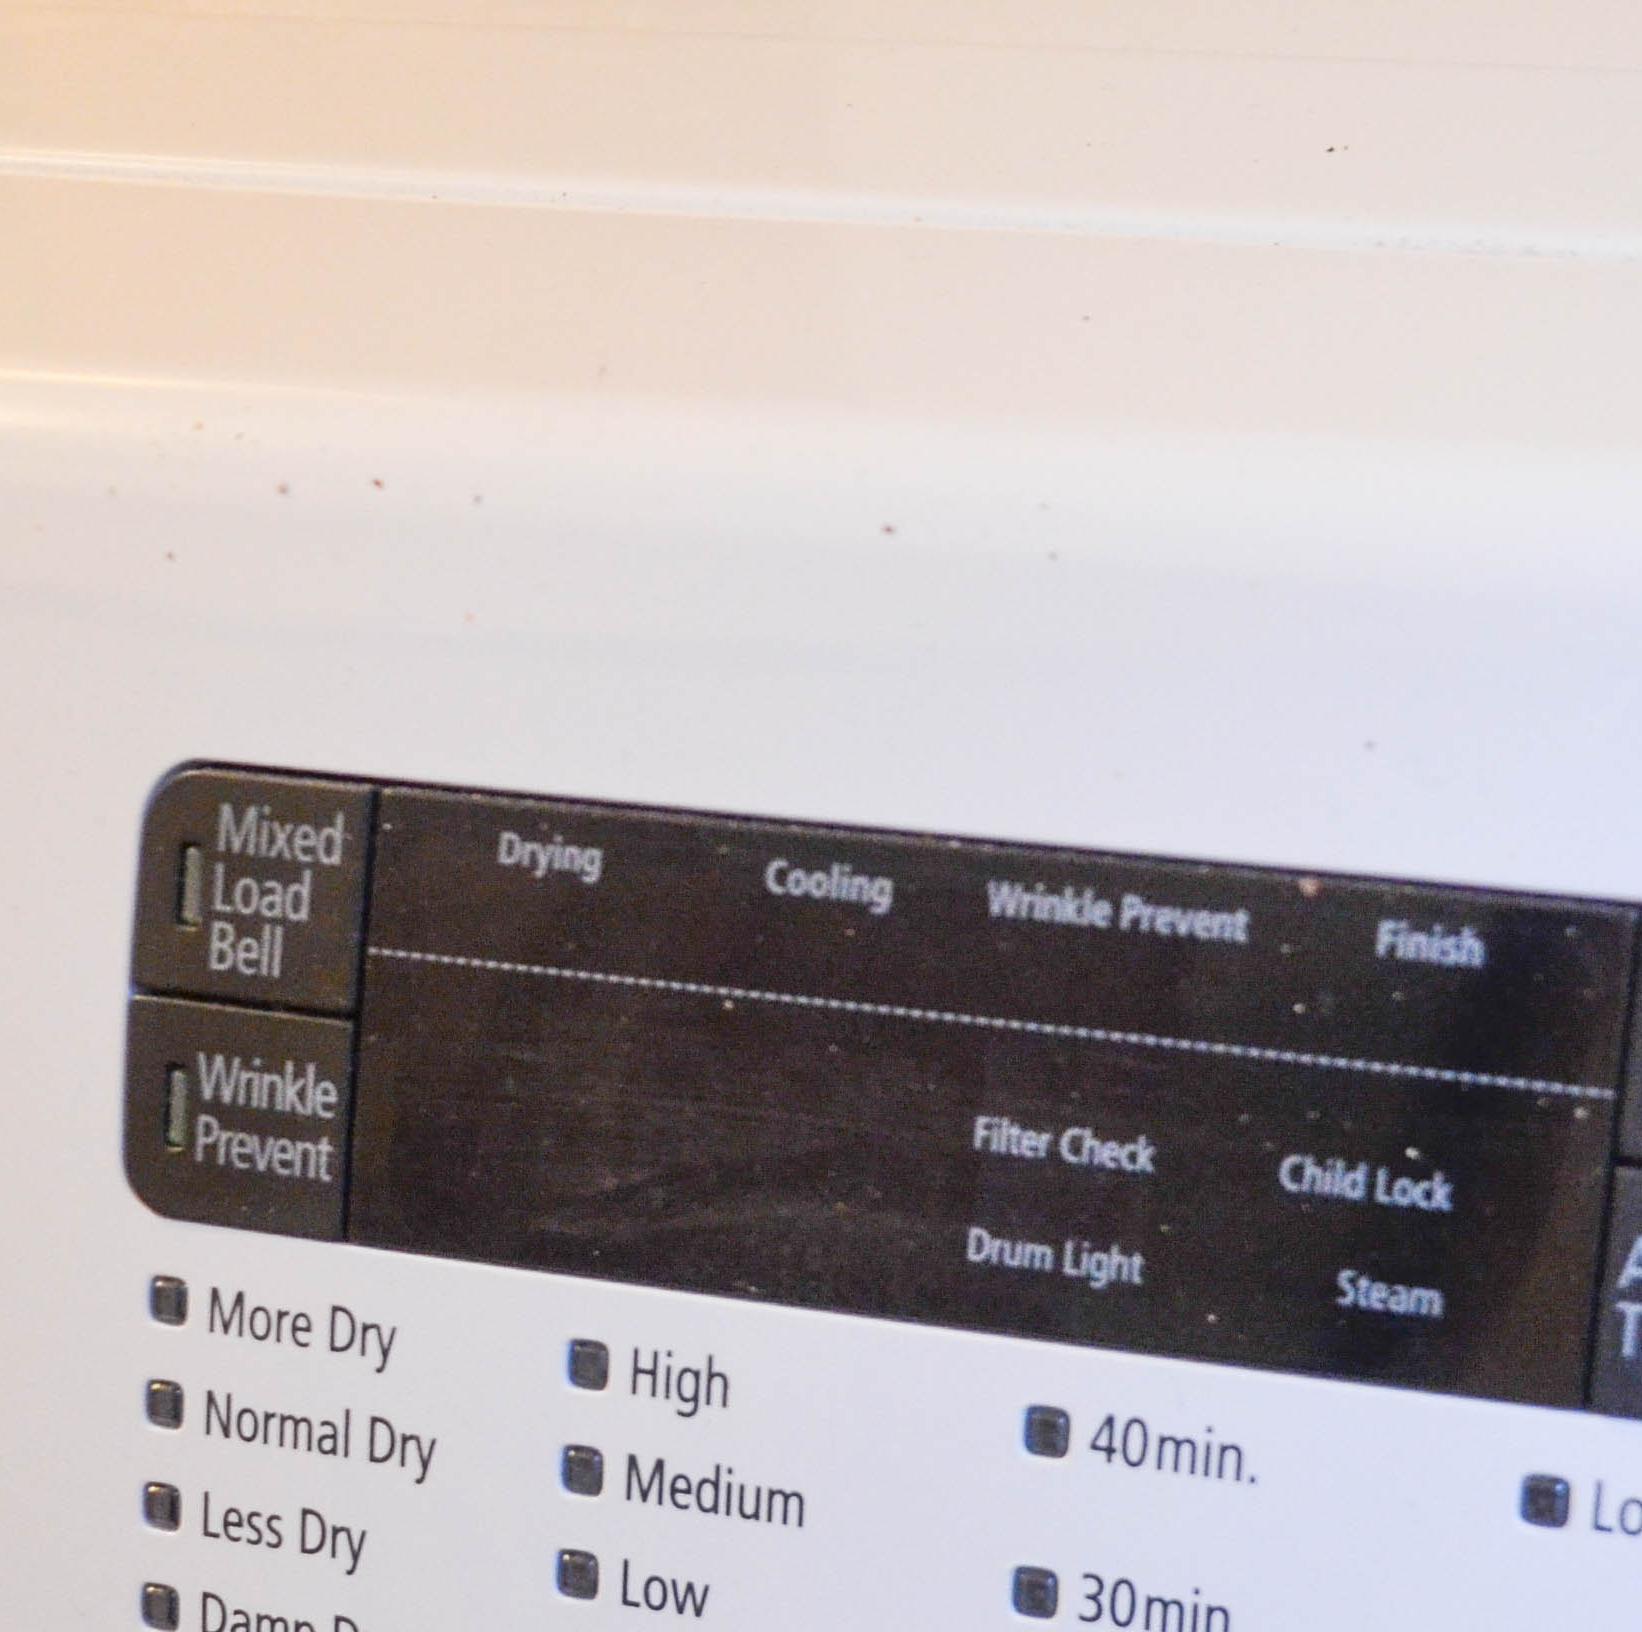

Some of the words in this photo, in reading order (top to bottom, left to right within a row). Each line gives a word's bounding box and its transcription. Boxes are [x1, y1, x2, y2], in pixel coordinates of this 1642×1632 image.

[215, 803, 344, 866] Mixed
[498, 831, 603, 884] Drying
[214, 863, 312, 921] Load
[765, 858, 894, 915] Cooling
[988, 882, 1112, 927] Wrinkle
[1119, 893, 1250, 943] Prevent
[210, 921, 283, 977] Bell
[1376, 920, 1484, 966] Finish
[197, 1052, 338, 1120] Wrinkle
[196, 1119, 334, 1182] Prevent
[974, 1115, 1052, 1158] Filter
[1059, 1127, 1154, 1172] Check
[1279, 1154, 1367, 1200] Child
[1375, 1168, 1451, 1211] Lock
[966, 1226, 1054, 1271] Drum
[1062, 1240, 1144, 1289] Light
[1337, 1269, 1443, 1316] Steam
[209, 1286, 312, 1348] More
[329, 1304, 396, 1374] Dry
[631, 1348, 729, 1418] High
[205, 1389, 351, 1458] Normal
[368, 1415, 437, 1485] Dry
[1089, 1414, 1258, 1482] 40min.
[625, 1453, 805, 1528] Medium
[202, 1491, 283, 1549] Less
[300, 1507, 367, 1576] Dry
[621, 1559, 710, 1618] Low
